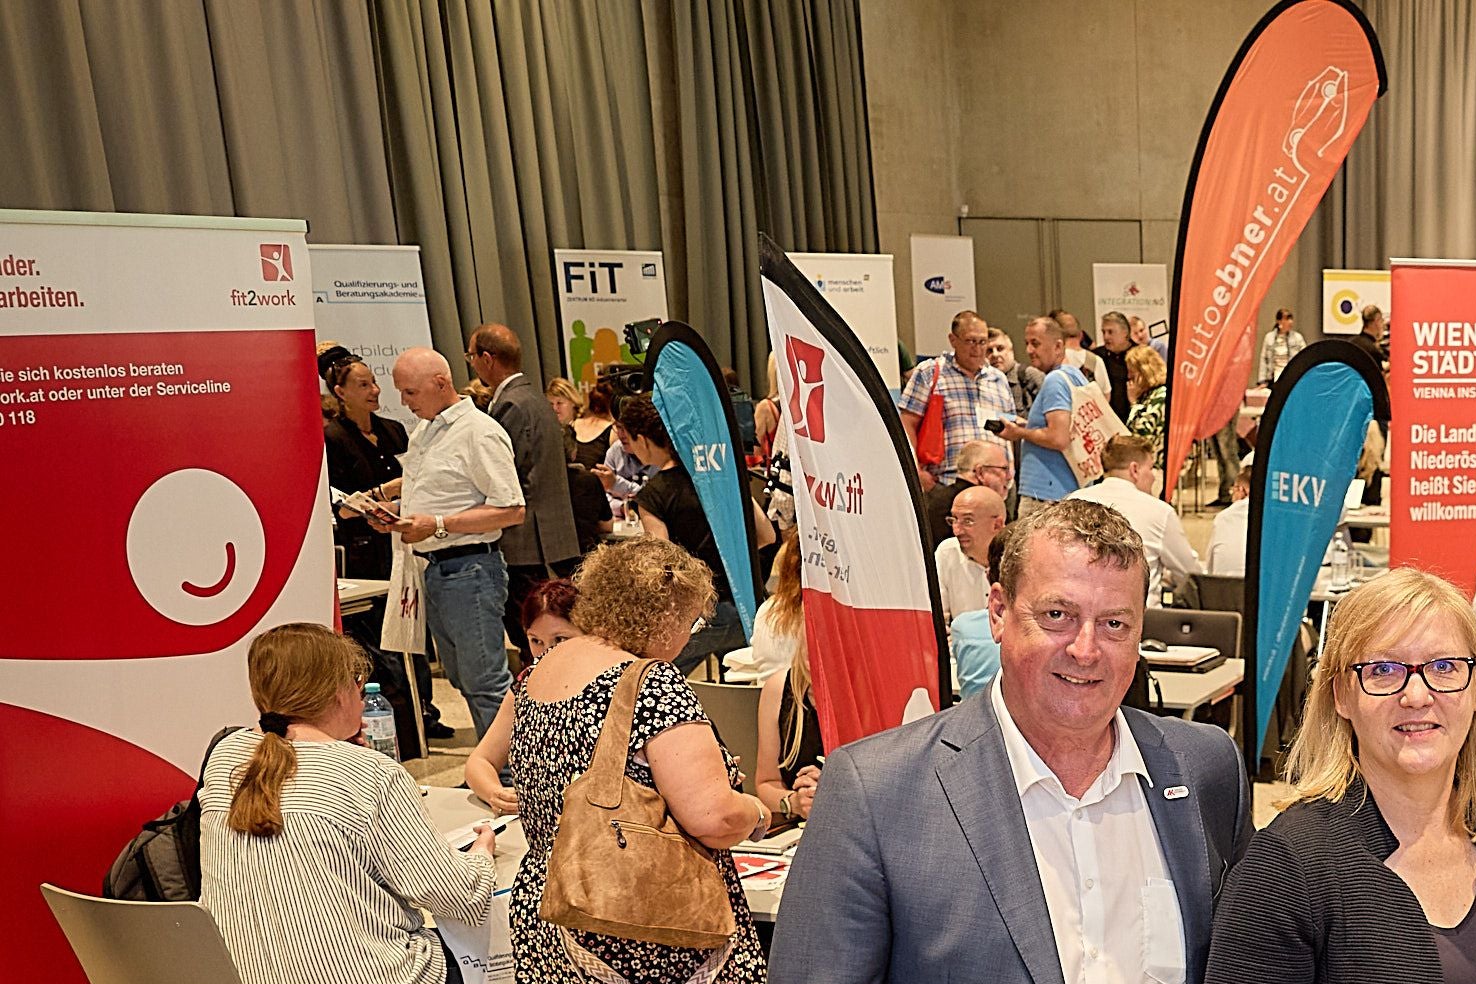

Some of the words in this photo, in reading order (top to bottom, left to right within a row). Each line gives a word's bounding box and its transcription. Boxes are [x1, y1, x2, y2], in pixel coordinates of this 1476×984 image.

[563, 261, 623, 294] FiT
[1180, 167, 1297, 380] autoebner.at
[333, 280, 399, 289] Qualifizierungs-
[401, 281, 418, 289] und
[335, 290, 418, 299] Beratungsakademie
[230, 289, 296, 306] fit2work
[18, 366, 50, 383] sich
[53, 363, 126, 381] kostenlos
[129, 361, 184, 377] beraten
[48, 386, 83, 402] oder
[87, 385, 126, 400] unter
[129, 383, 152, 398] der
[156, 379, 231, 396] Serviceline
[1413, 387, 1456, 399] VIENNA
[8, 409, 36, 426] 118
[1411, 424, 1437, 443] Die
[1278, 471, 1326, 508] EKV
[1410, 476, 1450, 496] heißt
[1452, 474, 1476, 495] Sie
